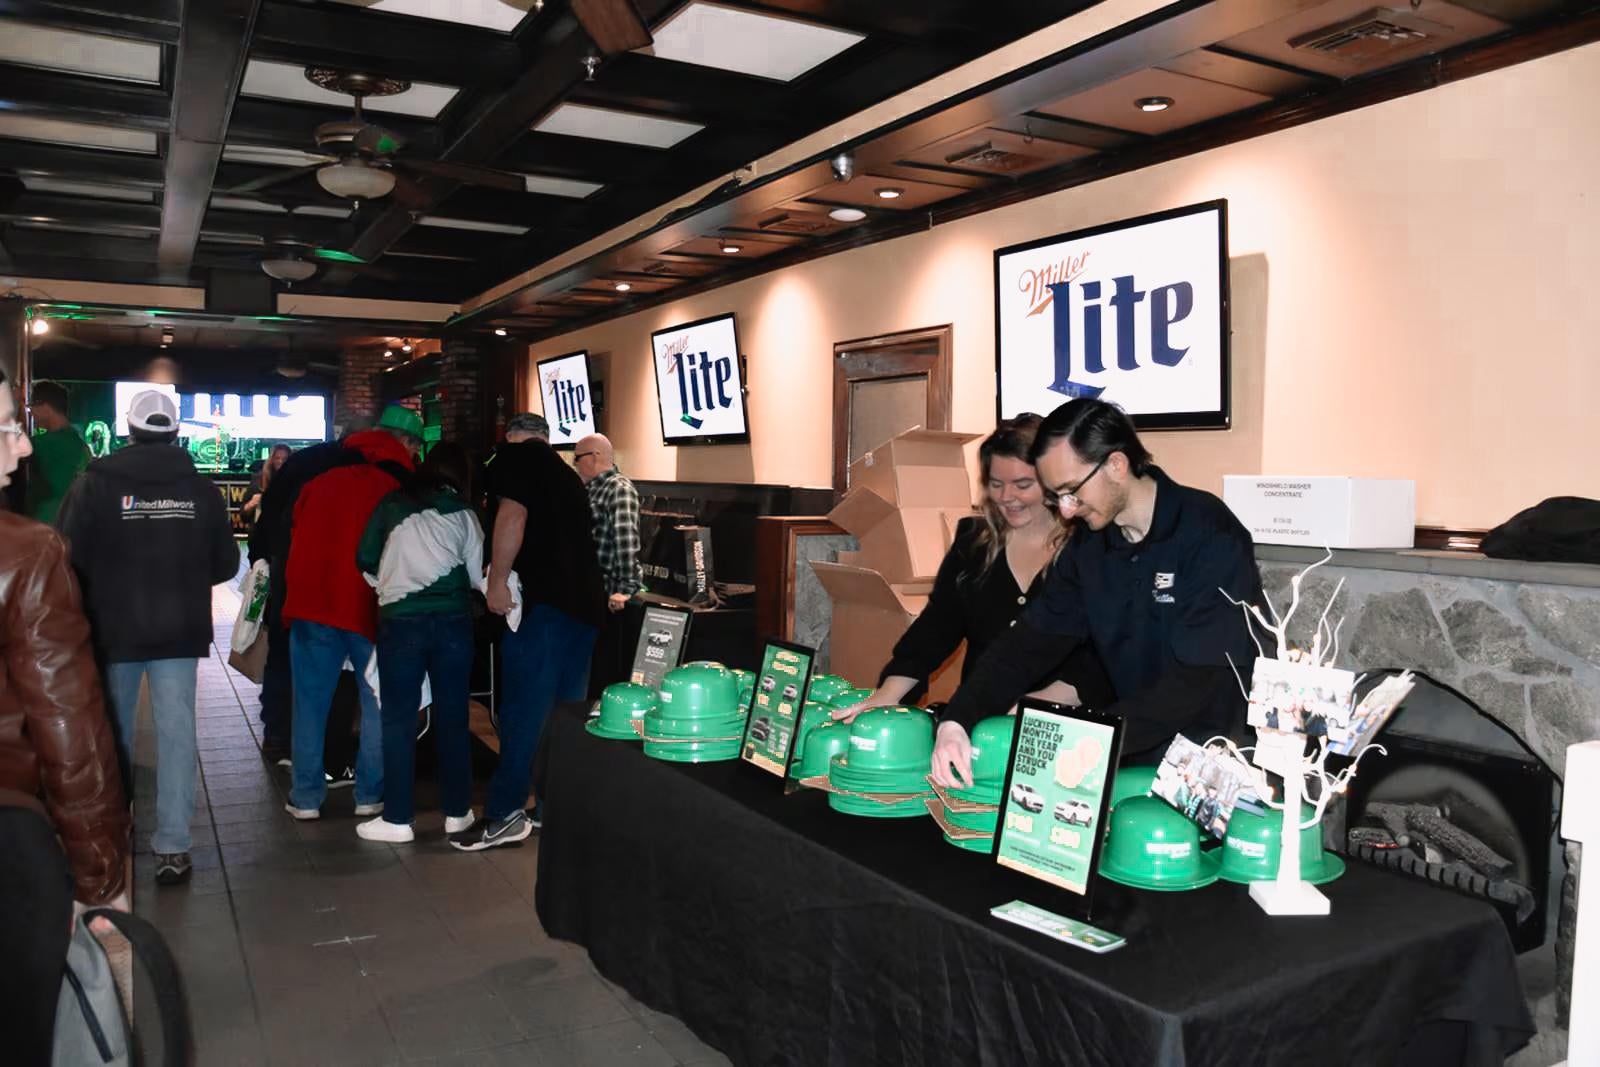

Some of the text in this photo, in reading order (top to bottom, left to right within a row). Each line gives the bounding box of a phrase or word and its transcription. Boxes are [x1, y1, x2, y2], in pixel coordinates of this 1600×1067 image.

[1018, 250, 1092, 309] Miller
[121, 495, 195, 510] United Millwork
[1023, 716, 1061, 732] LUCKIEST
[1023, 726, 1064, 743] MONTH OF
[1021, 736, 1058, 752] THE YEAR
[1018, 745, 1055, 761] AND YOU
[1017, 754, 1048, 769] STRUCK
[1016, 764, 1037, 776] GOLD
